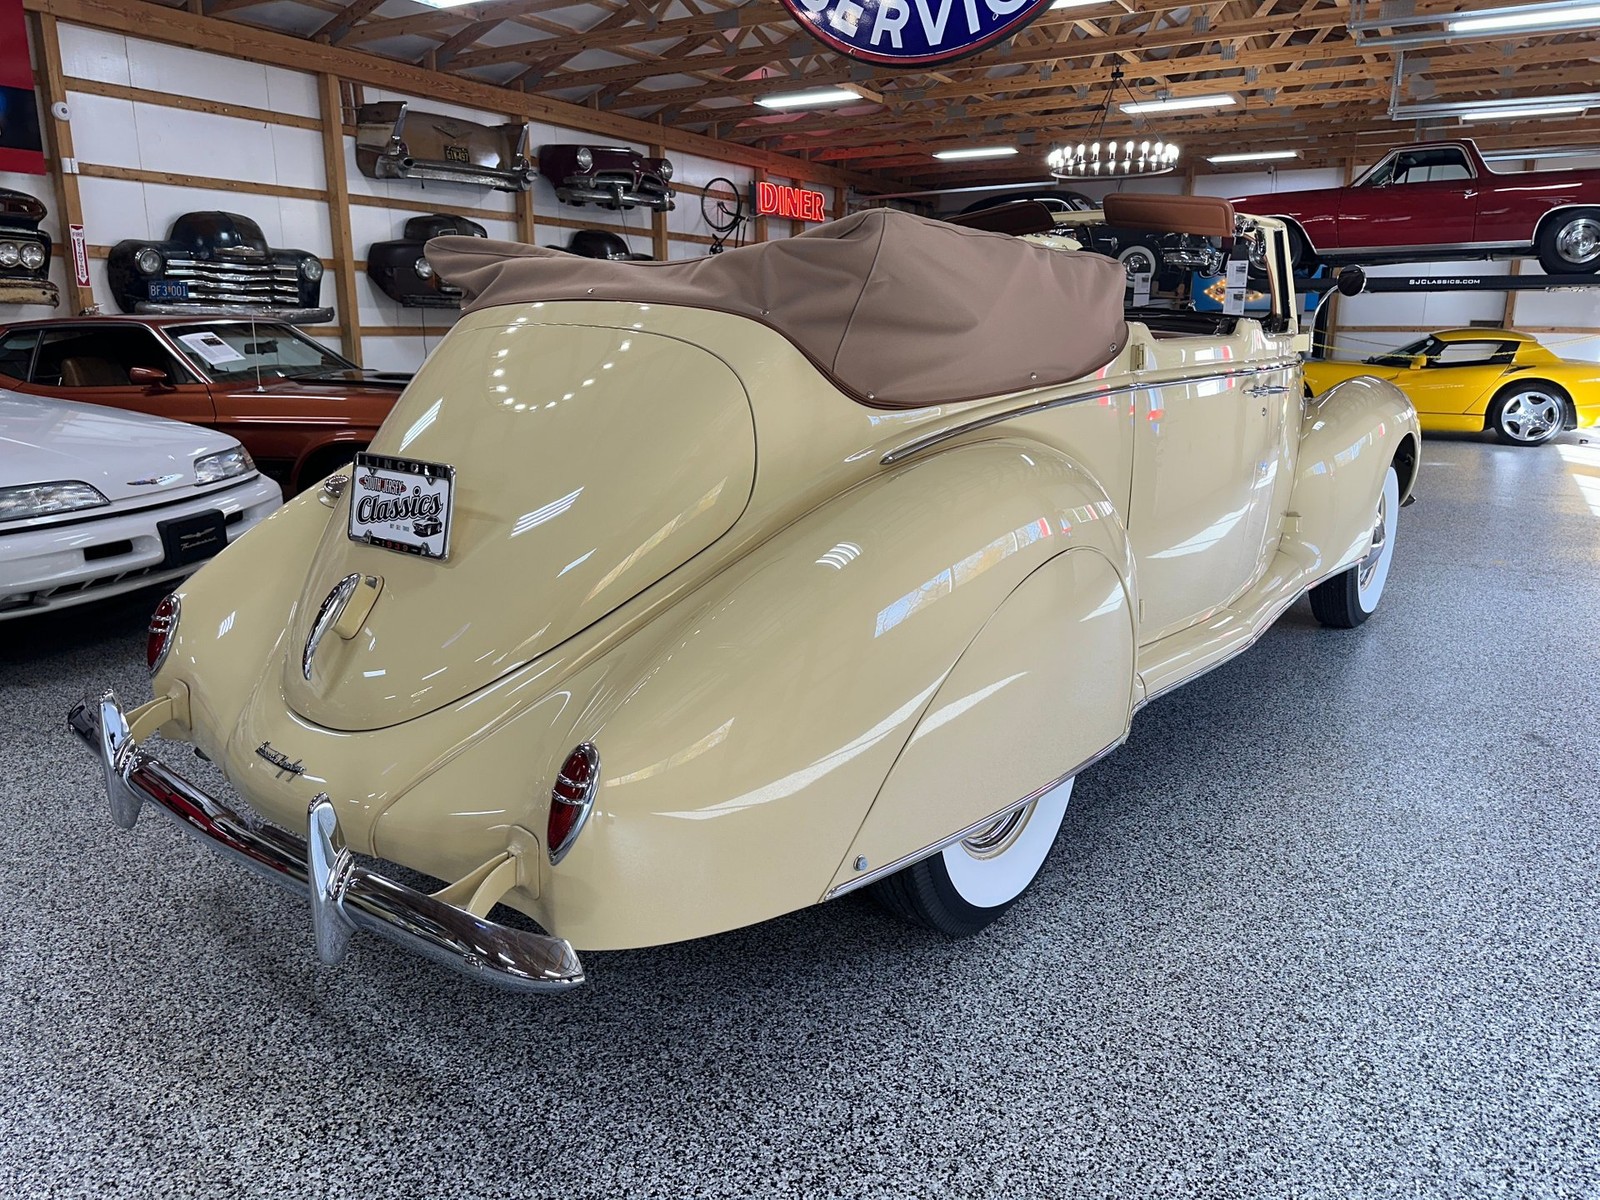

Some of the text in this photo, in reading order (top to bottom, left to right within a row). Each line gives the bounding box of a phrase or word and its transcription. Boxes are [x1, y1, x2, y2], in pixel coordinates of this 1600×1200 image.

[800, 0, 1037, 49] ERVI
[759, 181, 826, 222] DINER
[363, 475, 404, 496] SOUTH JERSEY
[365, 456, 446, 478] LINCOLN
[356, 485, 444, 525] Classics
